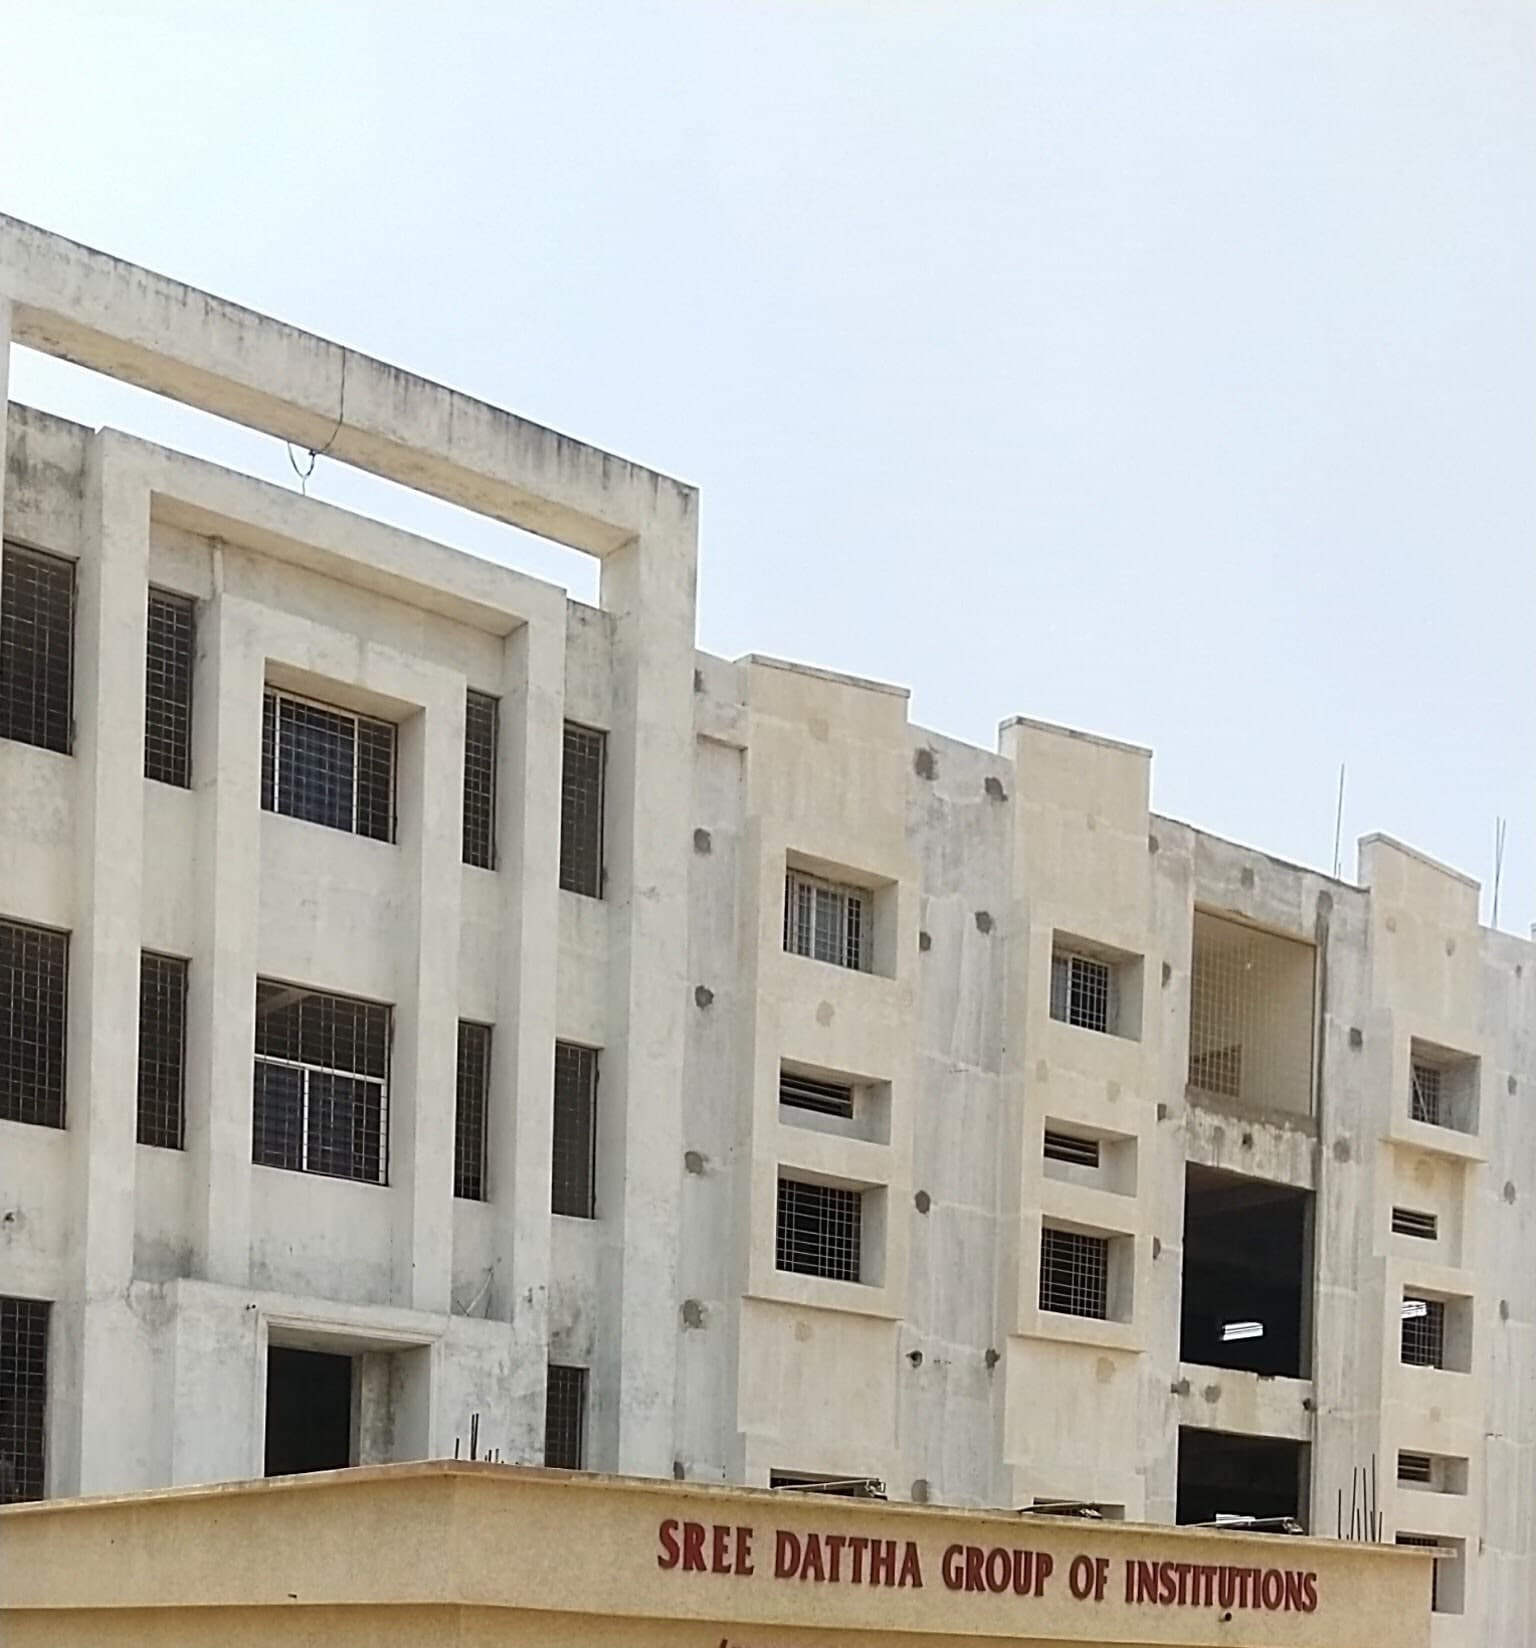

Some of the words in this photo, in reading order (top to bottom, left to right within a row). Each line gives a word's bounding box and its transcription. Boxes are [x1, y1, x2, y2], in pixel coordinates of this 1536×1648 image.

[657, 1518, 755, 1576] SREE
[773, 1529, 923, 1588] DATTHA
[941, 1543, 1053, 1598] GROUP
[1068, 1554, 1110, 1602] OF
[1124, 1559, 1318, 1613] INSTITUTIONS
